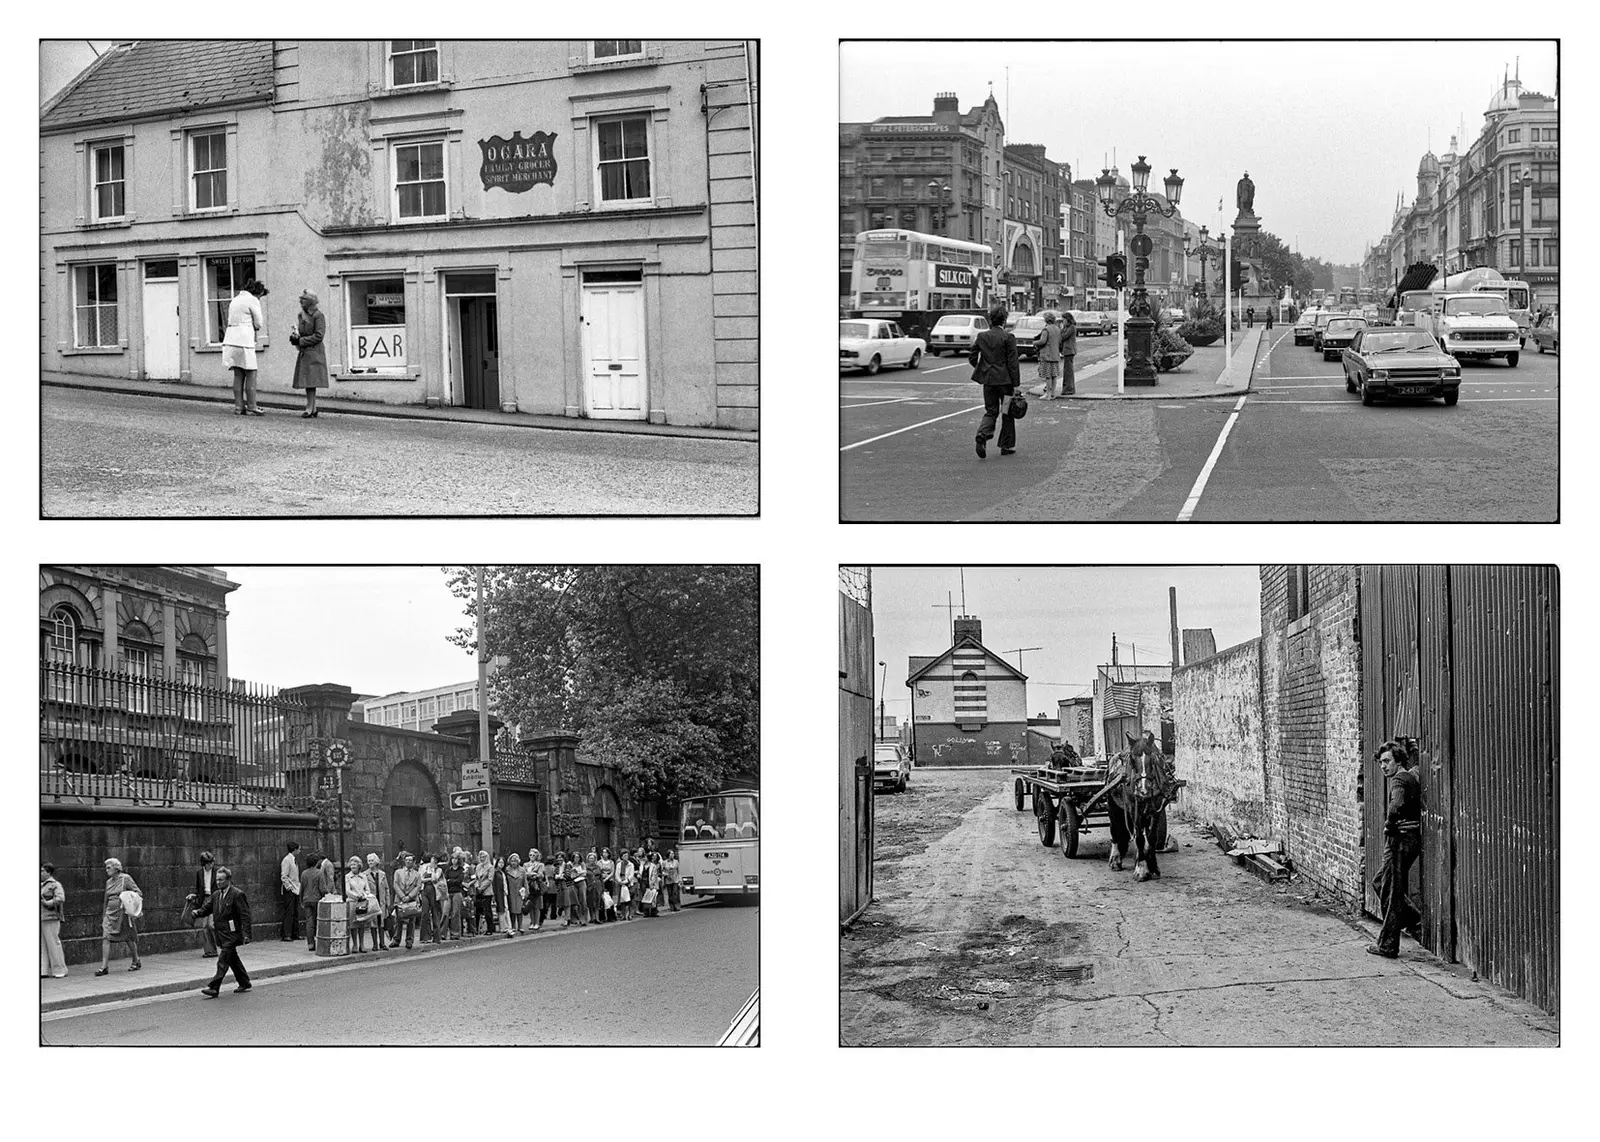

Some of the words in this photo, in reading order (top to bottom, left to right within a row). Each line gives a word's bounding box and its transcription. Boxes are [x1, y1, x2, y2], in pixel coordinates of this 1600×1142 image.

[518, 159, 551, 170] GROCER
[512, 170, 552, 182] MERCHANT
[939, 269, 958, 284] SILK
[958, 270, 972, 285] CUT
[358, 334, 403, 359] BAR
[470, 794, 477, 802] N
